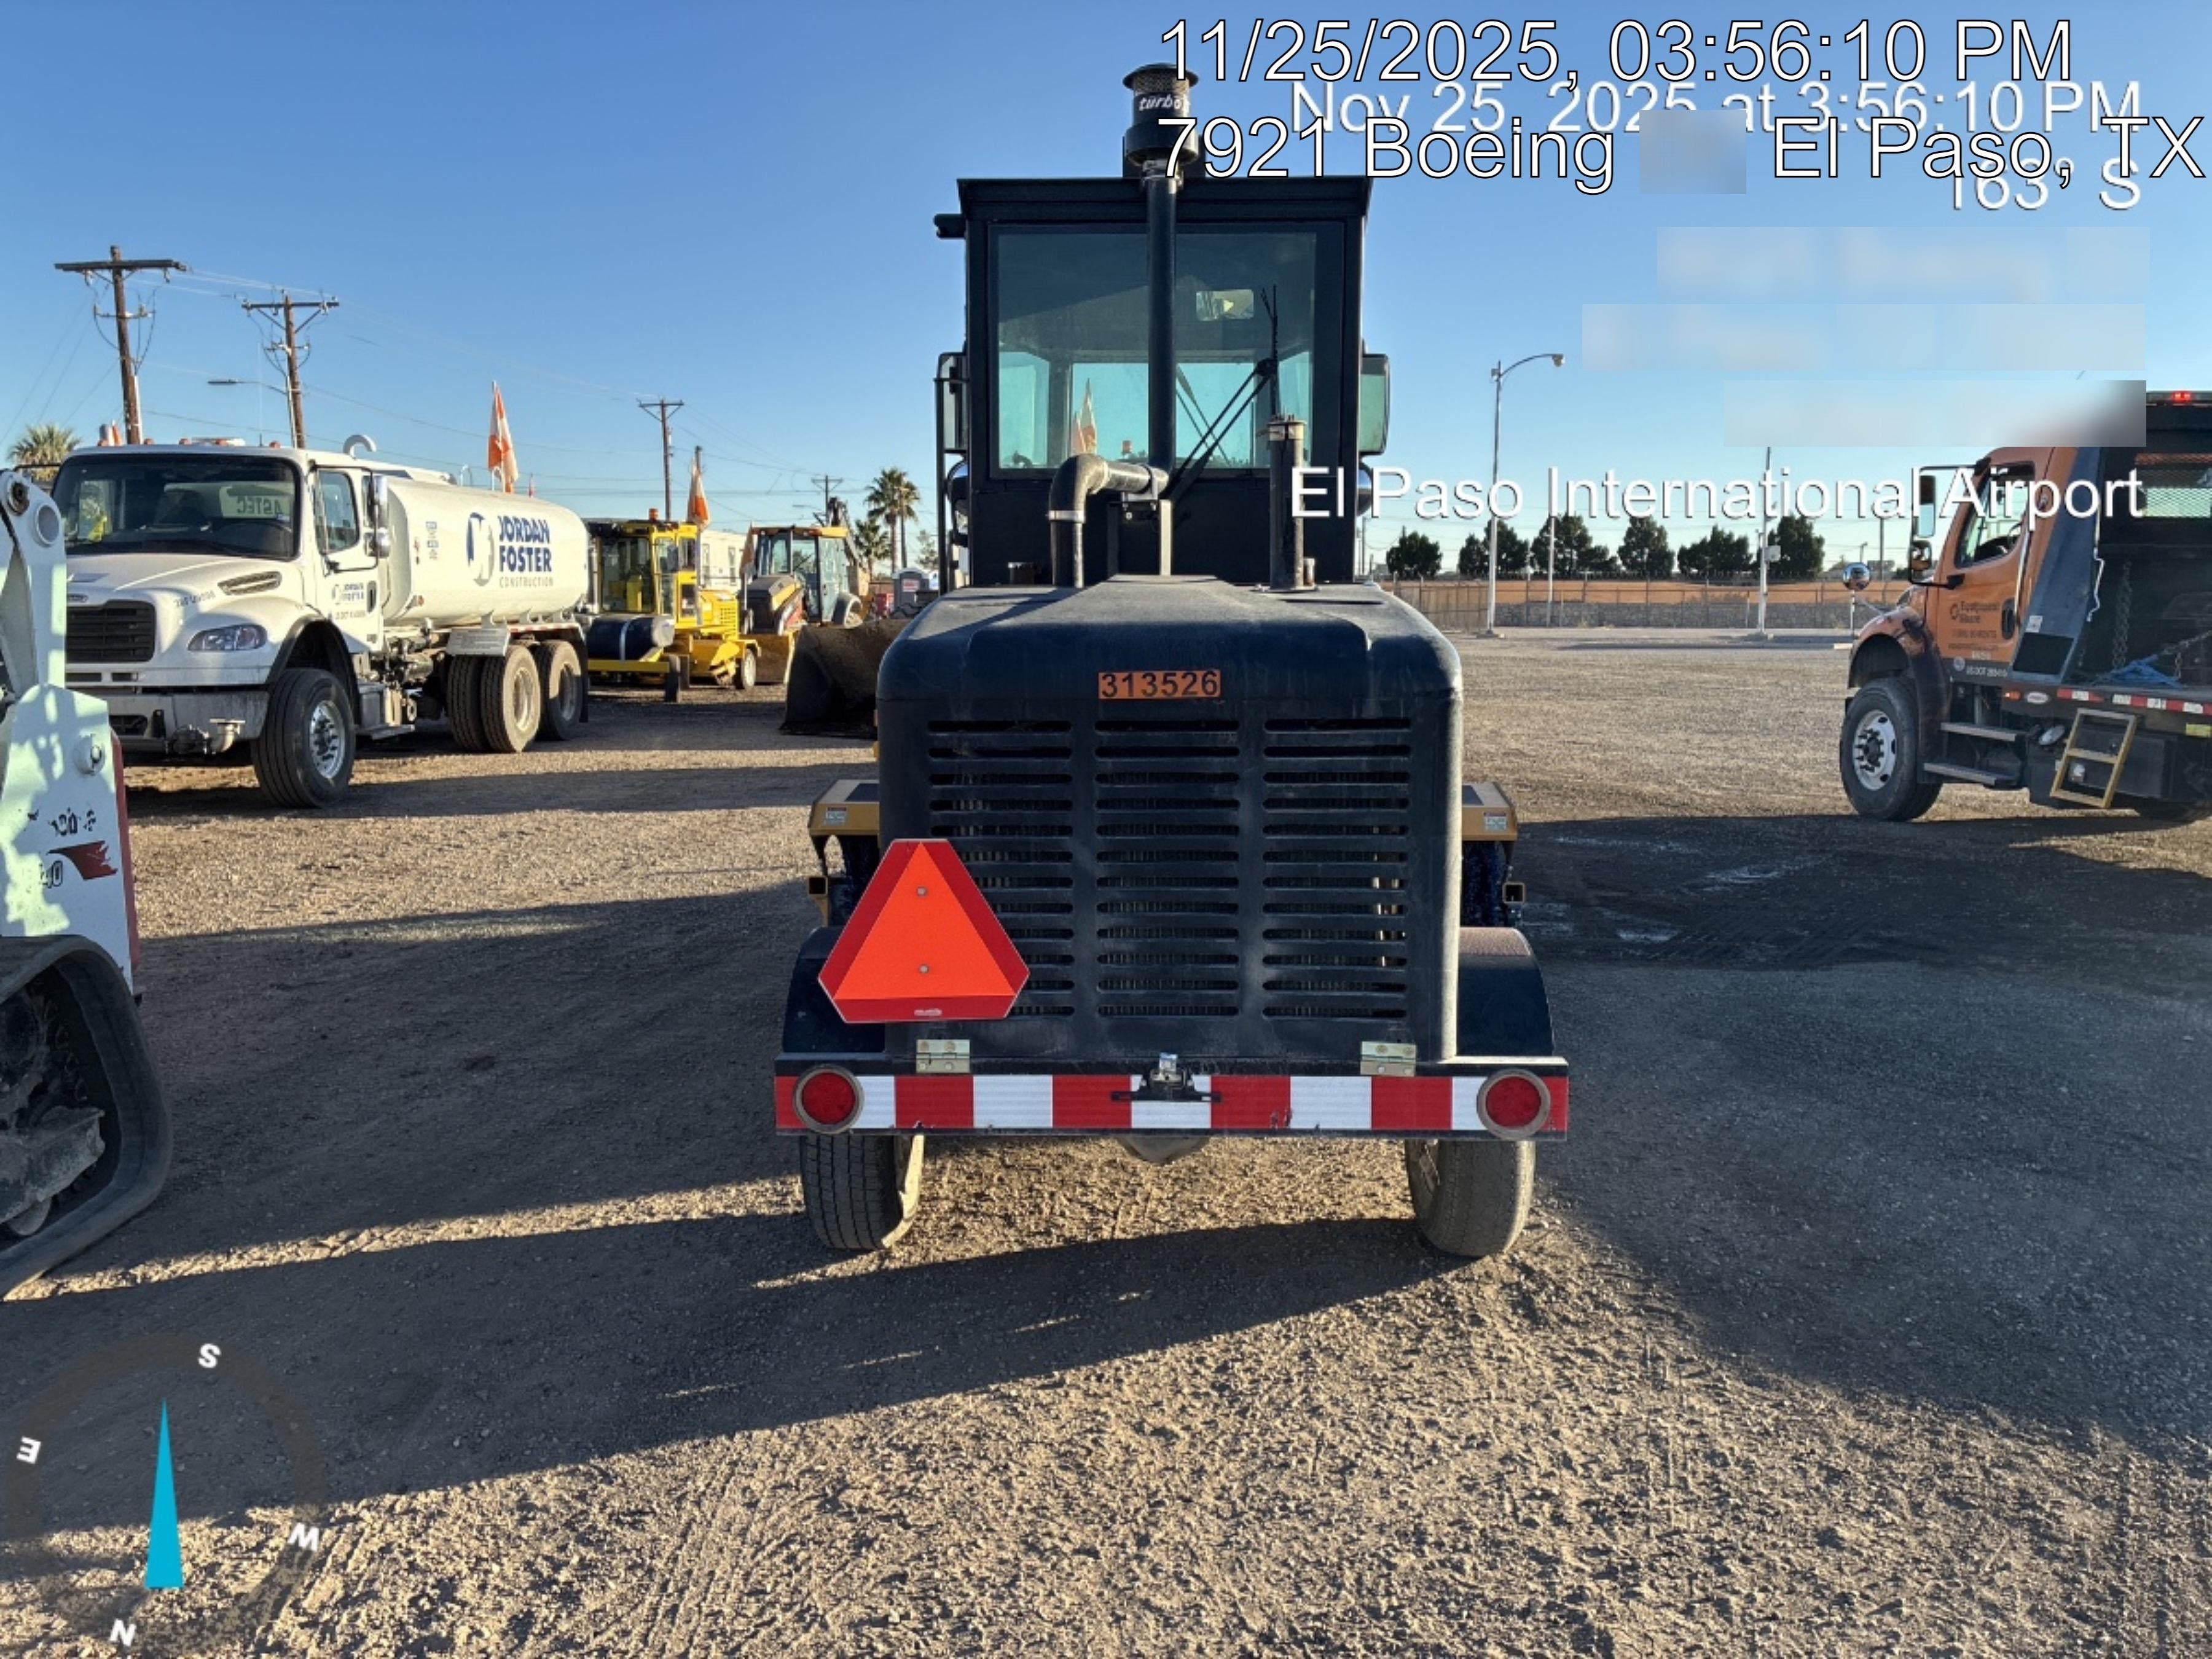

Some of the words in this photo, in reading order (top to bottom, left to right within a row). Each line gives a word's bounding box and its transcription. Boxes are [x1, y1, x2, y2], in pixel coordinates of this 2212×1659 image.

[498, 516, 551, 544] JORDAN
[499, 545, 552, 573] FOSTER
[498, 576, 554, 588] CONSTRUCTION
[1102, 670, 1217, 697] 313526
